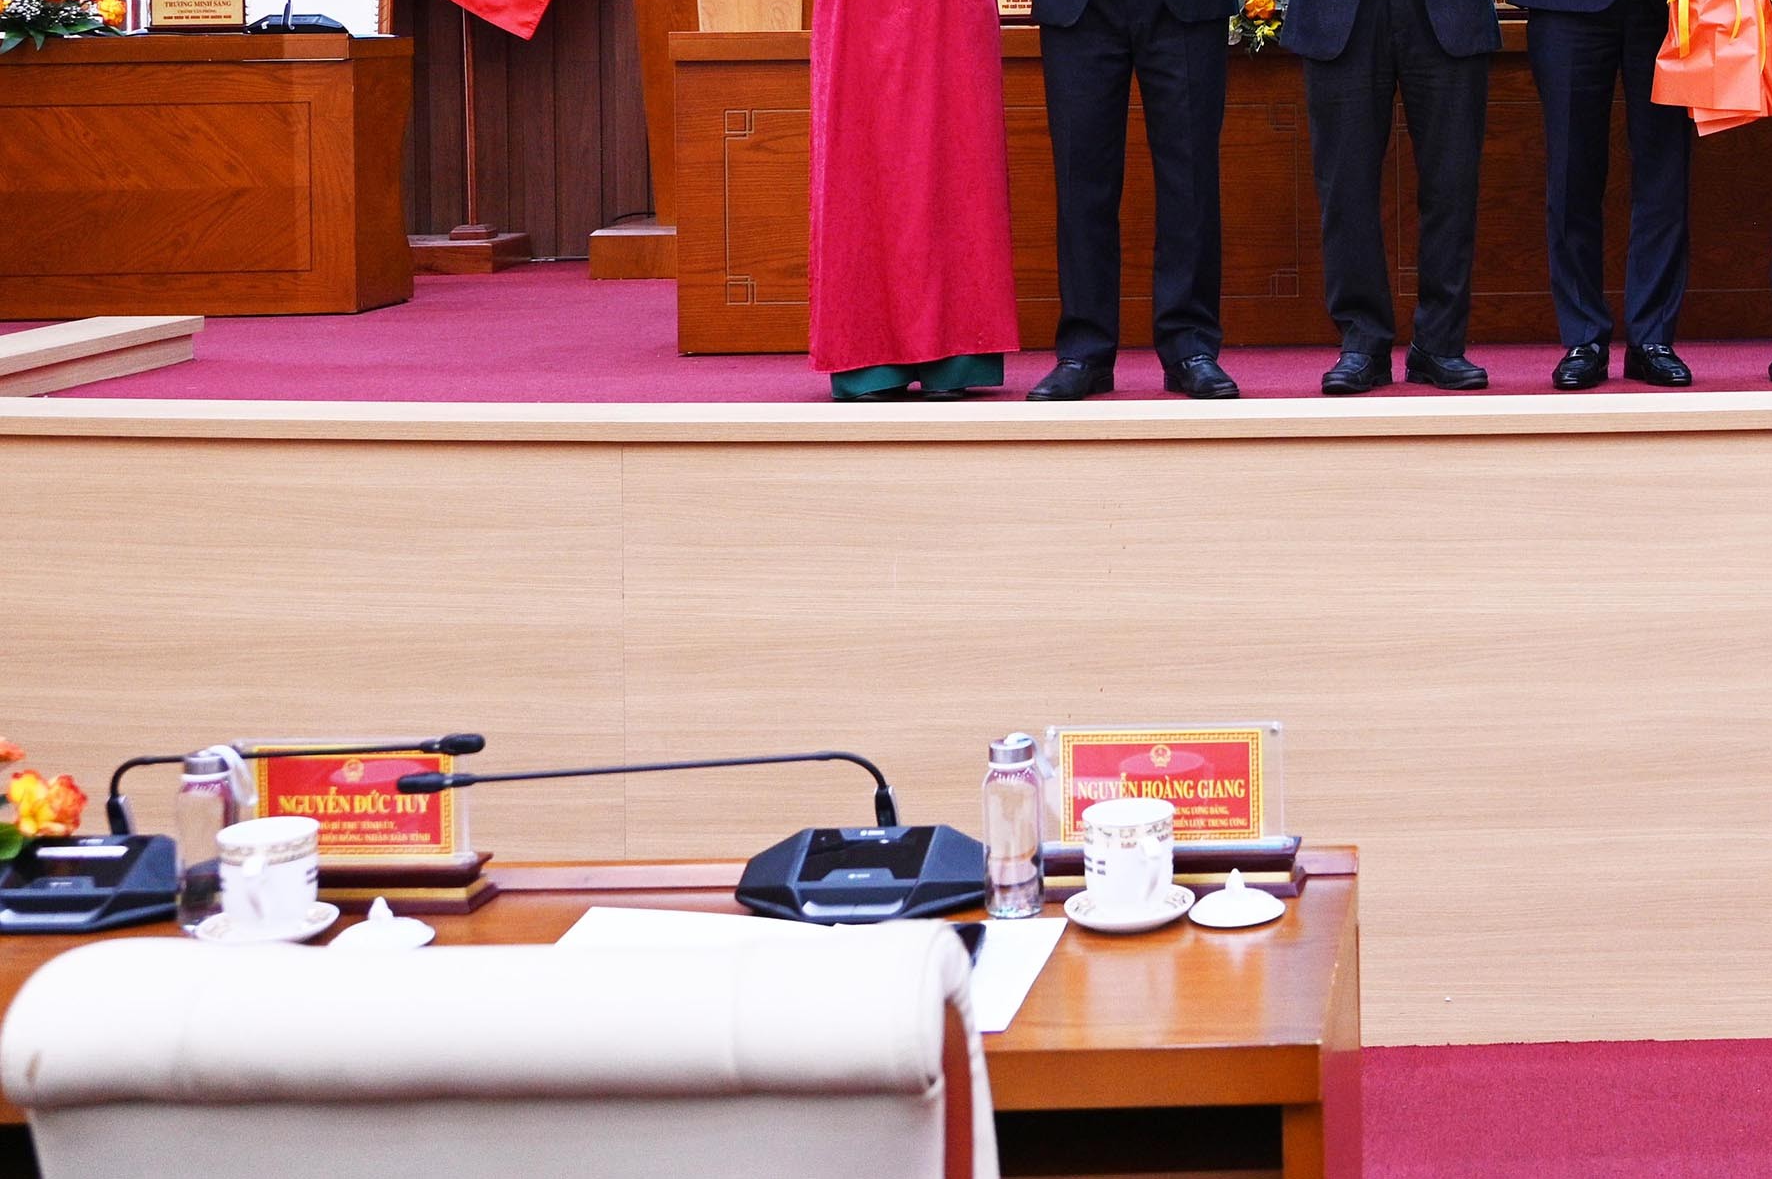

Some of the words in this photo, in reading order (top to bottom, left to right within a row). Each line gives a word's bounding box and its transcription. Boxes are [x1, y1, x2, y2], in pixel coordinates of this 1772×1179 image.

[278, 786, 350, 814] NGUYỄN
[354, 789, 391, 814] ĐỨC
[395, 794, 430, 814] TUY
[1077, 772, 1138, 800] NGUYỄN
[1142, 775, 1194, 799] HOÀNG
[1197, 778, 1245, 798] GIANG
